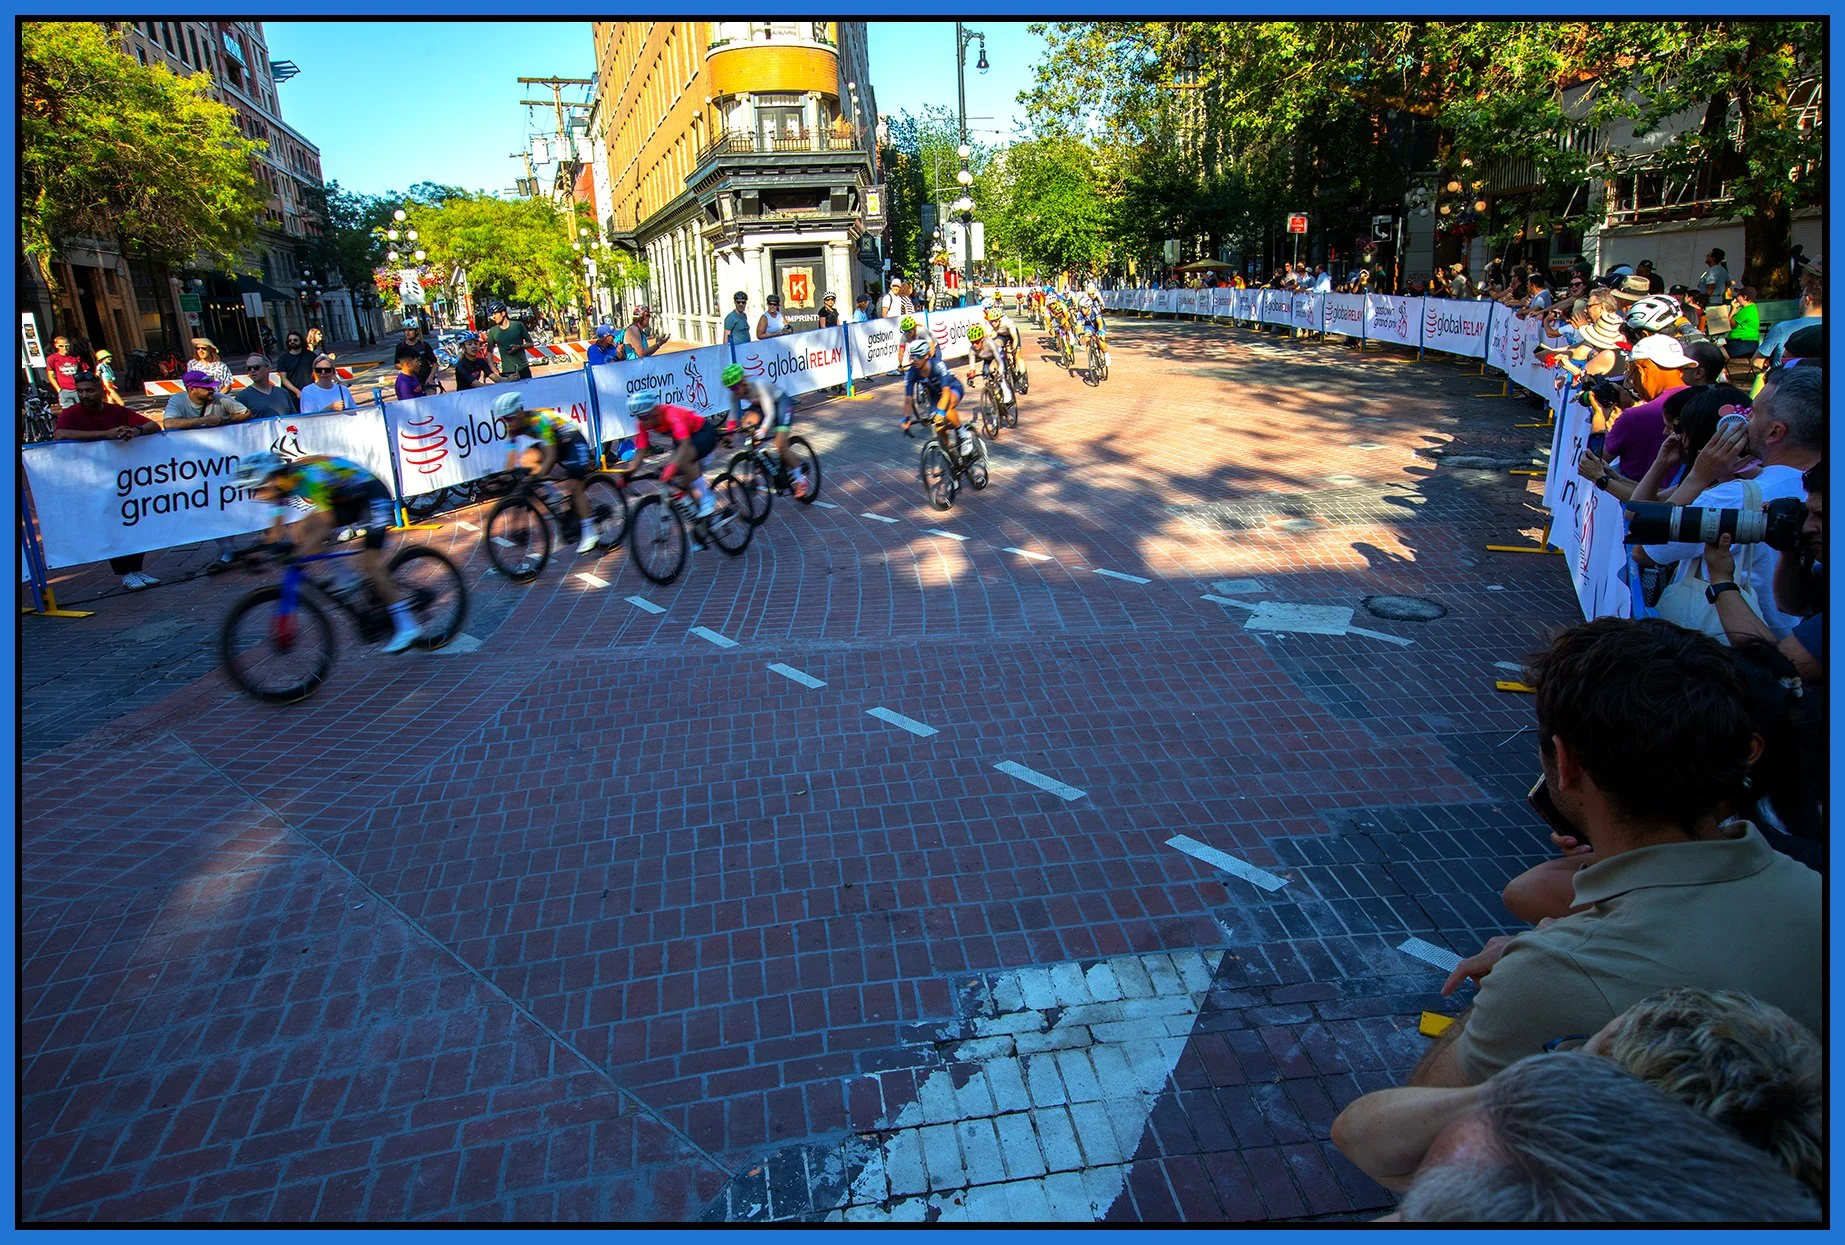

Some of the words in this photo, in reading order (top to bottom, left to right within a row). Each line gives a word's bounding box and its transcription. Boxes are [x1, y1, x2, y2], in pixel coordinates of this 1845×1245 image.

[791, 280, 806, 296] K
[868, 330, 894, 348] gastown
[867, 342, 888, 363] grand
[626, 372, 675, 394] gastown
[665, 387, 684, 405] prix
[117, 454, 240, 497] gastown
[121, 481, 209, 527] grand
